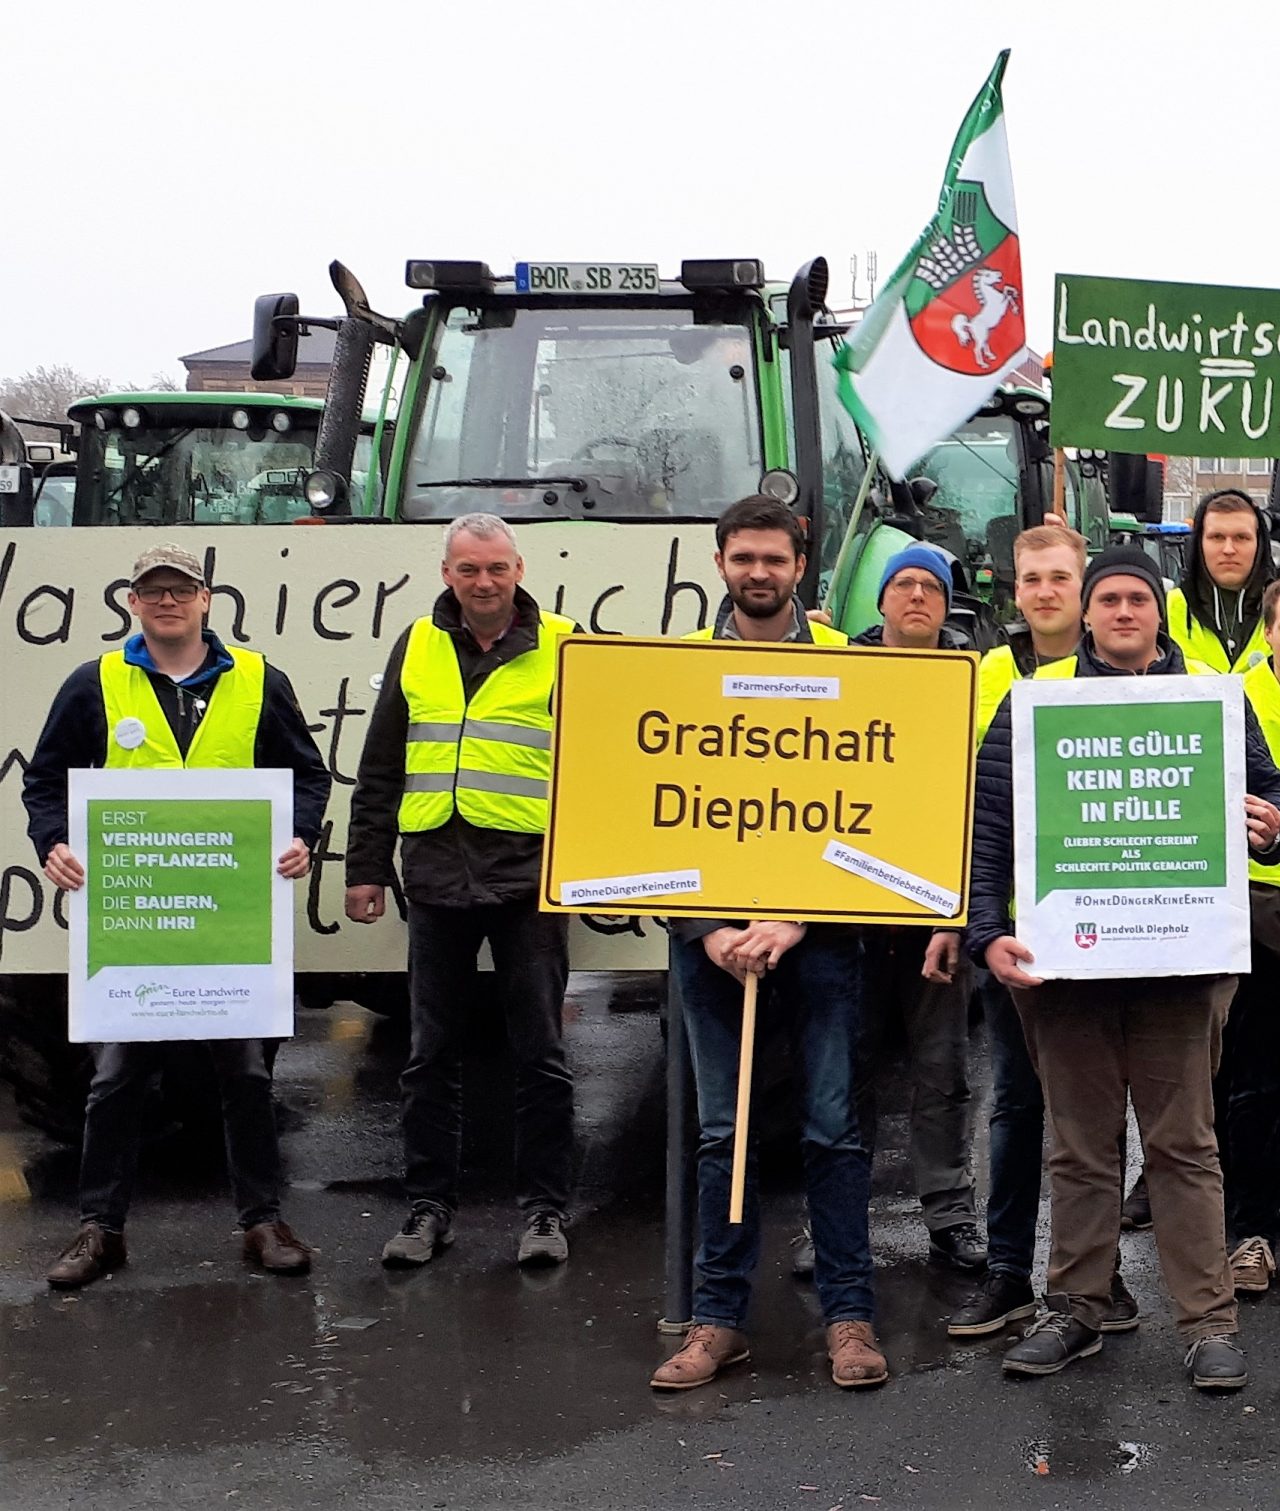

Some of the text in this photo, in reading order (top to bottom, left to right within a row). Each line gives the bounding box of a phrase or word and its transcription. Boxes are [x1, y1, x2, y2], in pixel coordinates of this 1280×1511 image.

[530, 266, 569, 289] BOR
[586, 267, 611, 289] SB
[618, 267, 656, 290] 235
[0, 541, 132, 646] as
[201, 546, 410, 643] hier
[732, 680, 828, 695] #FarmersForFuture
[636, 709, 896, 764] Grafschaft
[1056, 731, 1202, 759] OHNE GÜLLE
[1067, 766, 1194, 791] KEIN BROT
[652, 783, 874, 843] Diepholz
[1081, 796, 1182, 823] IN FÜLLE
[102, 811, 147, 826] ERST
[101, 832, 234, 847] VERHUNGERN
[1063, 835, 1198, 848] (LIEBER SCHLECHT GEREIMT
[102, 853, 239, 870] DIE PFLANZEN,
[1121, 849, 1141, 859] ALS
[1055, 860, 1208, 873] SCHLECHTE POLITIK GEMACHT!)
[102, 874, 153, 889] DANN
[833, 847, 954, 911] #FamilienbetriebeErhalten
[570, 878, 698, 900] #OhneDüngerKeineErnte
[102, 895, 218, 912] DIE BAUERN,
[102, 916, 196, 931] DANN IHR!
[1101, 924, 1190, 935] Landvolk Diepholz
[108, 989, 132, 998] Echt
[198, 987, 250, 998] Landwirte
